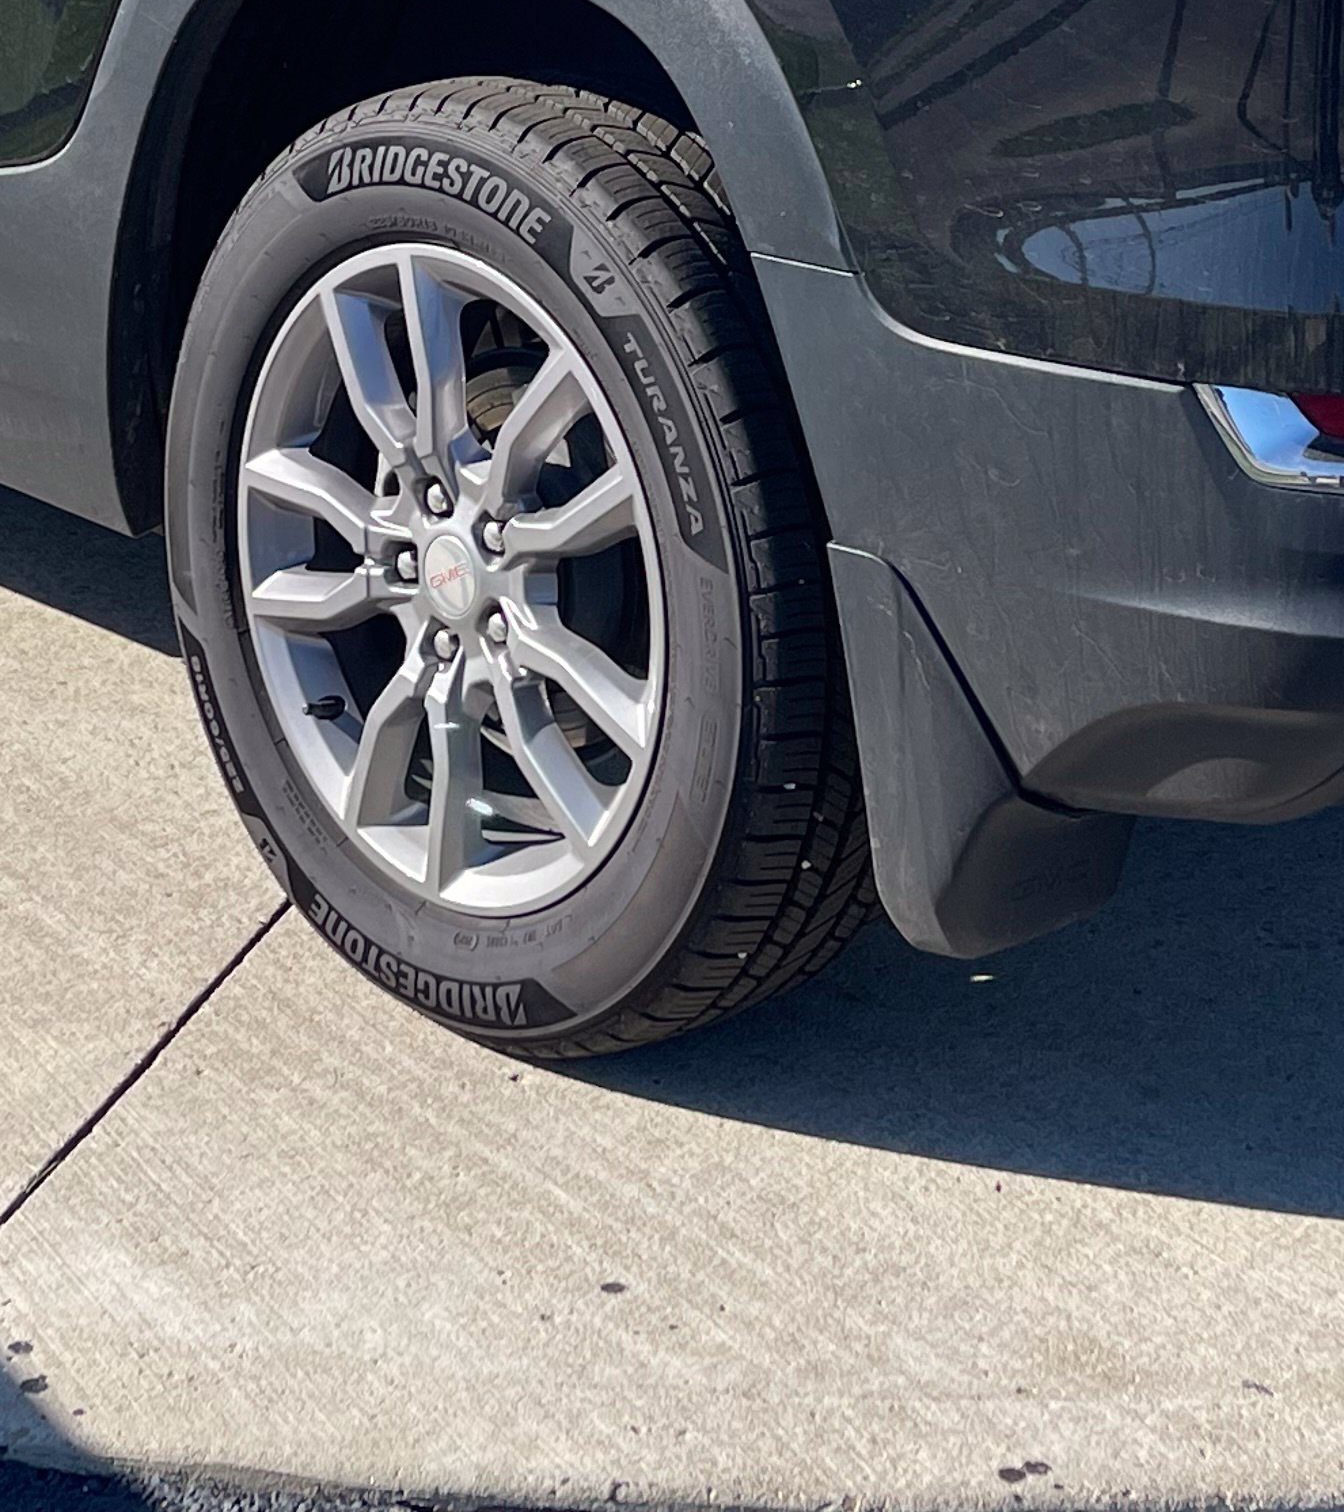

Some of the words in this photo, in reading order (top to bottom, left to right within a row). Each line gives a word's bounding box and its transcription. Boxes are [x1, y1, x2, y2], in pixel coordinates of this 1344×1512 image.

[326, 145, 552, 244] BRIDGESTONE
[623, 332, 704, 536] TURANZA
[430, 560, 468, 589] GMC
[308, 892, 528, 1026] BRIDGESTONE
